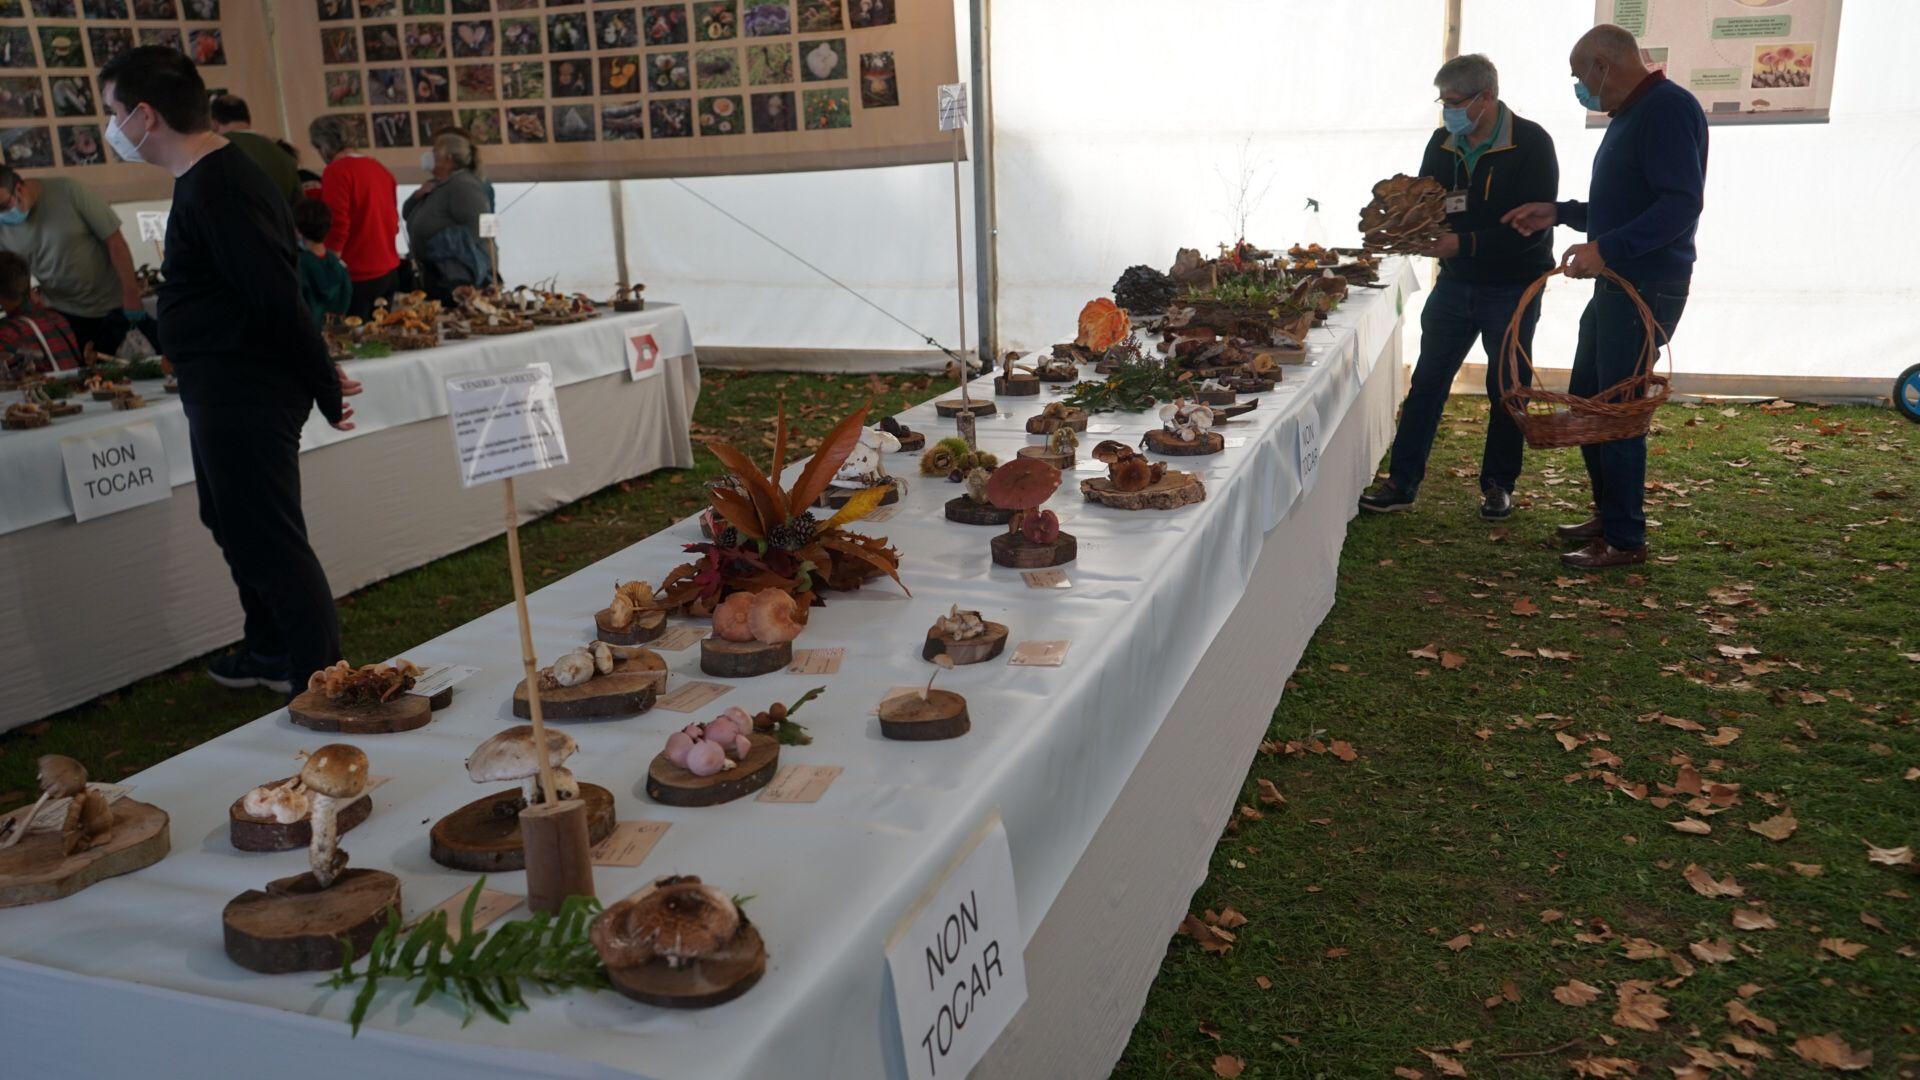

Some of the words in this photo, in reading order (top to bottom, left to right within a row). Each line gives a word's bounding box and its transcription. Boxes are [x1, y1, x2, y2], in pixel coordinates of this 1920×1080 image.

[84, 467, 154, 499] TOCAR
[92, 444, 136, 470] NON
[925, 890, 979, 991] NON
[922, 940, 1003, 1077] TOCAR
